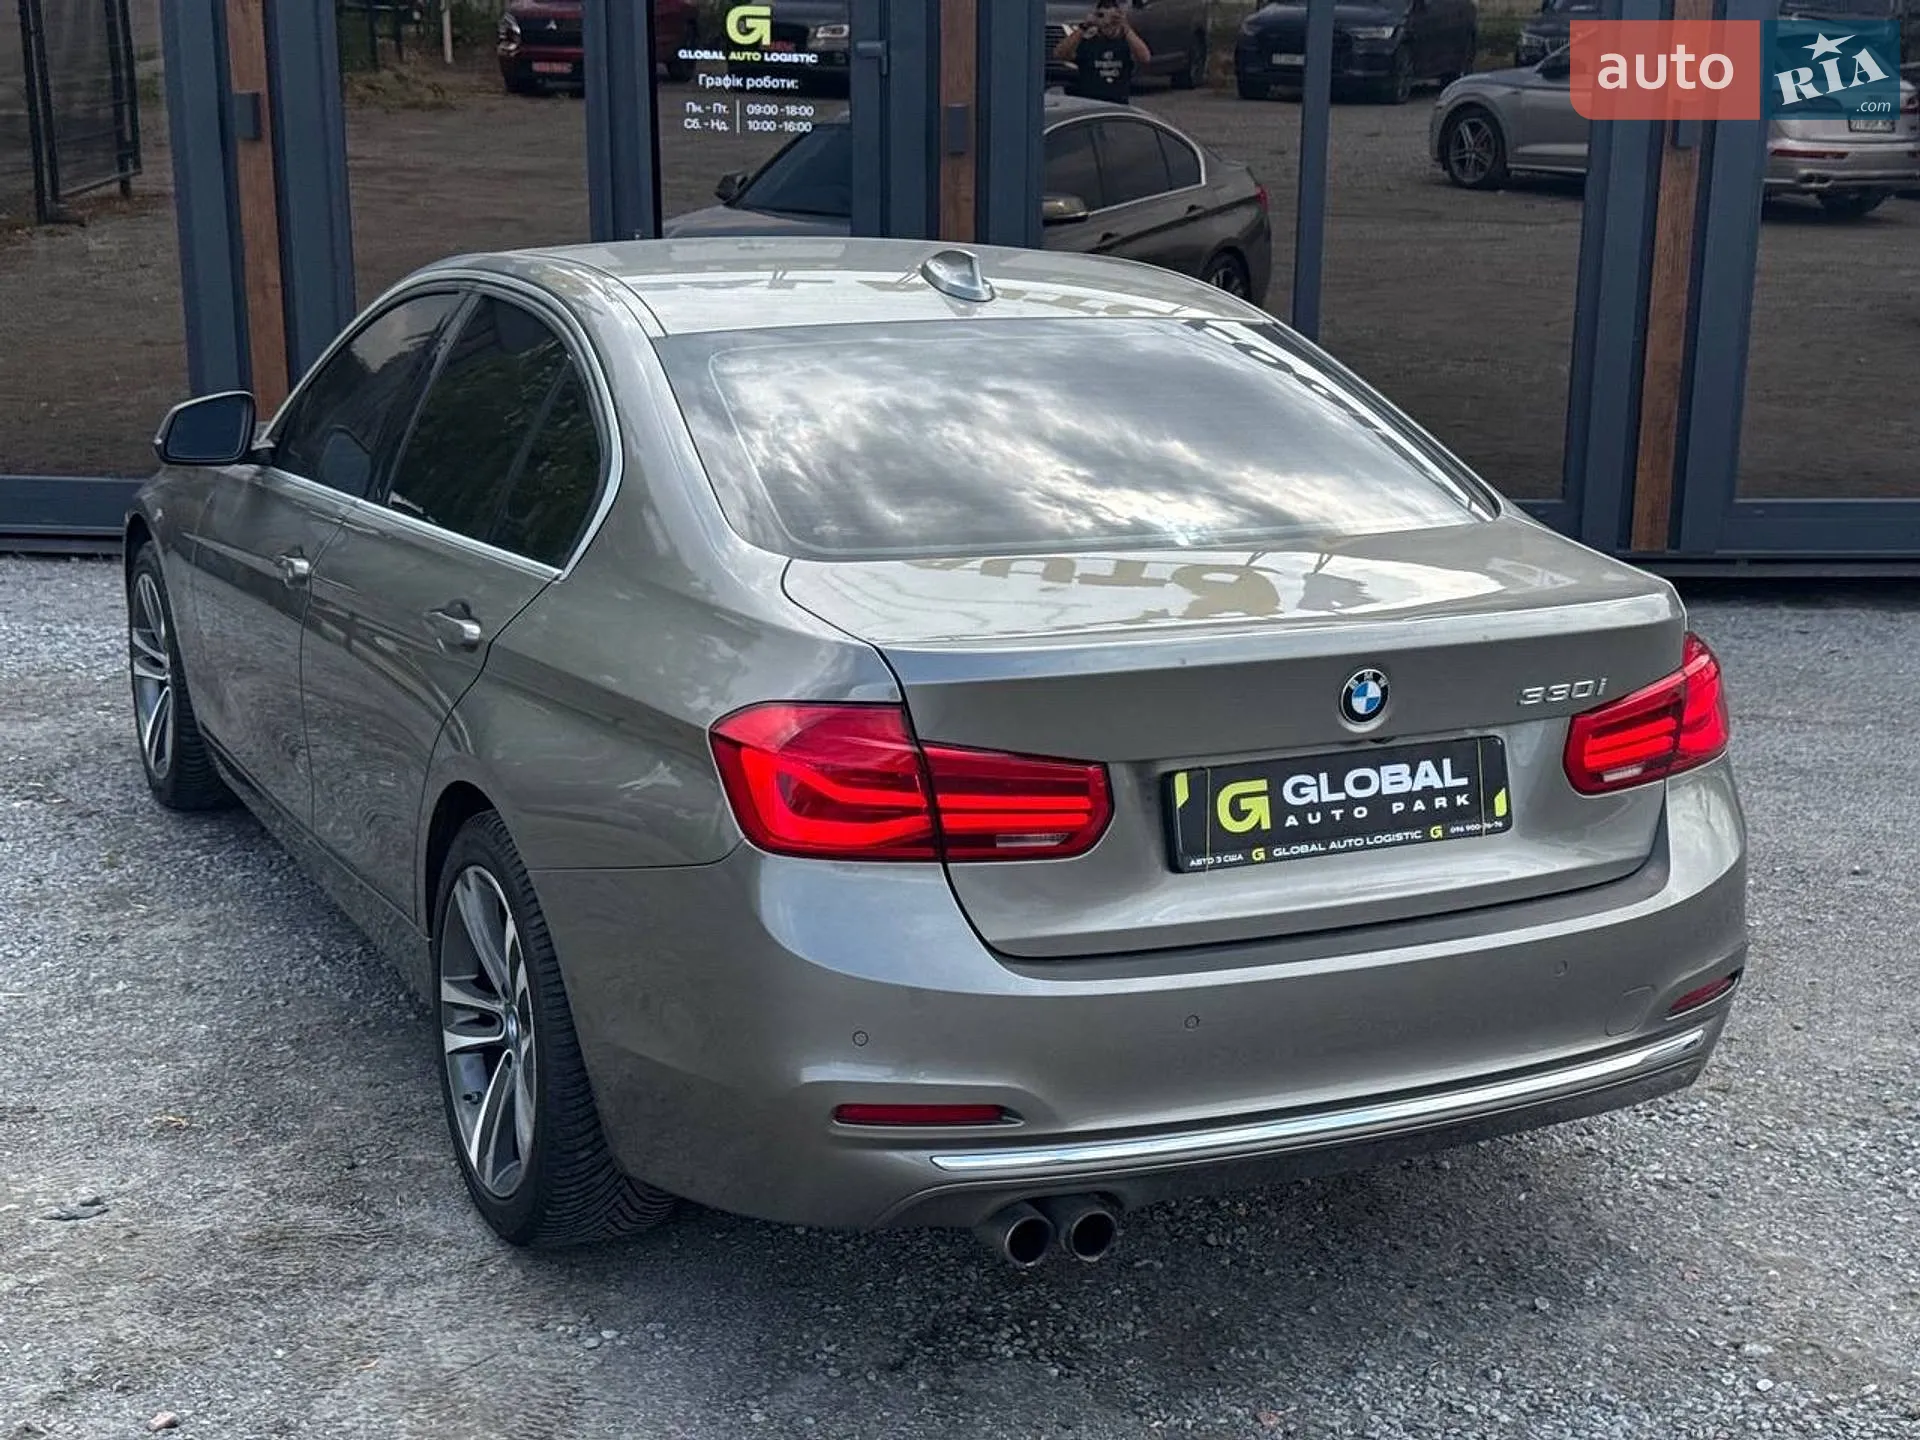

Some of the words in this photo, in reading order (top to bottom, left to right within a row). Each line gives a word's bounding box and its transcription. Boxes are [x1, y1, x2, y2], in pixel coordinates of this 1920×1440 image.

[678, 49, 726, 60] GLOBAL
[728, 51, 761, 61] AUTO
[763, 52, 818, 63] LOGISTIC
[698, 73, 743, 89] Графік
[746, 75, 799, 90] роботи:
[686, 101, 704, 114] Пн.
[712, 102, 729, 114] Пт.
[746, 104, 778, 116] 09:00
[684, 118, 701, 129] Сб.
[747, 119, 777, 132] 10:00
[1518, 678, 1608, 705] 330i
[1282, 758, 1468, 805] GLOBAL
[1285, 806, 1368, 827] AUTO
[1391, 793, 1470, 814] PARK
[1273, 842, 1326, 857] GLOBAL
[1328, 836, 1364, 850] AUTO
[1366, 829, 1422, 845] LOGISTIC
